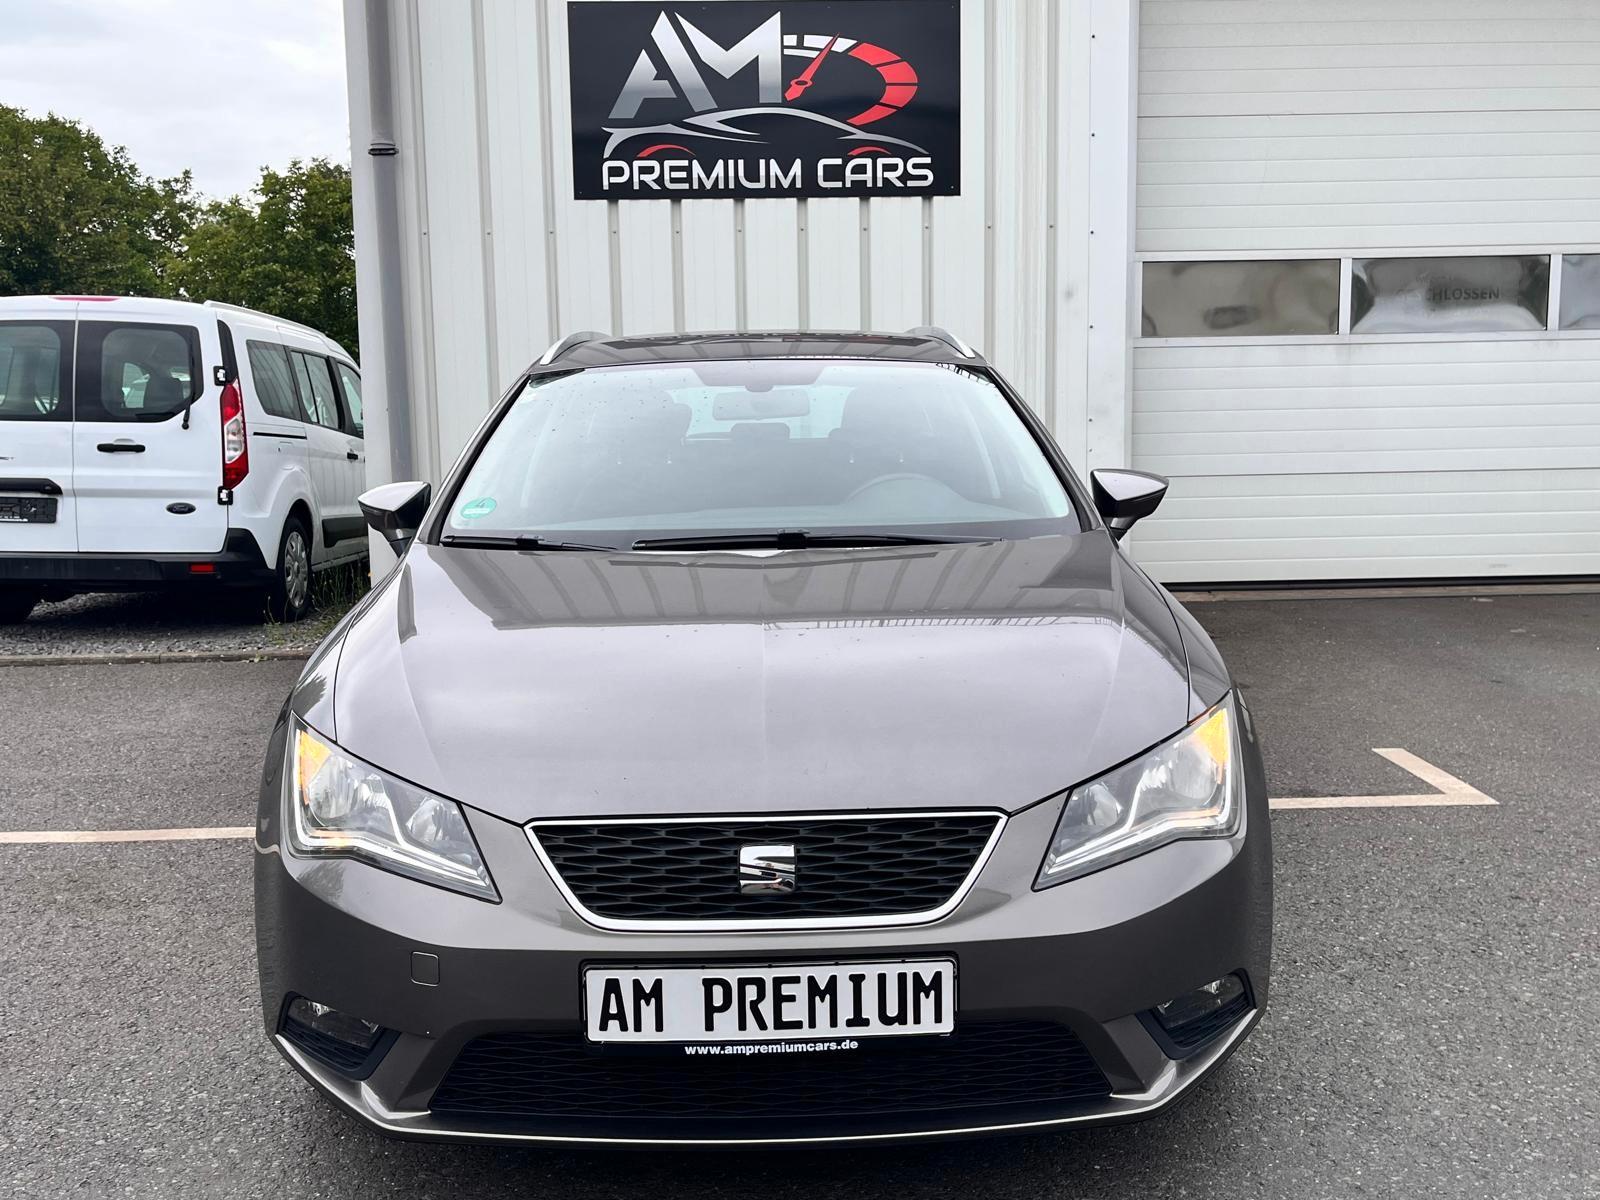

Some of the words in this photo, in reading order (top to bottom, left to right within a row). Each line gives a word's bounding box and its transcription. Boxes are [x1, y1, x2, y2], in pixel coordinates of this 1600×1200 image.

[602, 159, 802, 190] PREMIUM
[817, 157, 934, 187] CARS
[598, 977, 664, 1032] AM
[701, 970, 943, 1032] PREMIUM
[684, 1039, 859, 1056] www.ampremiumcars.de
